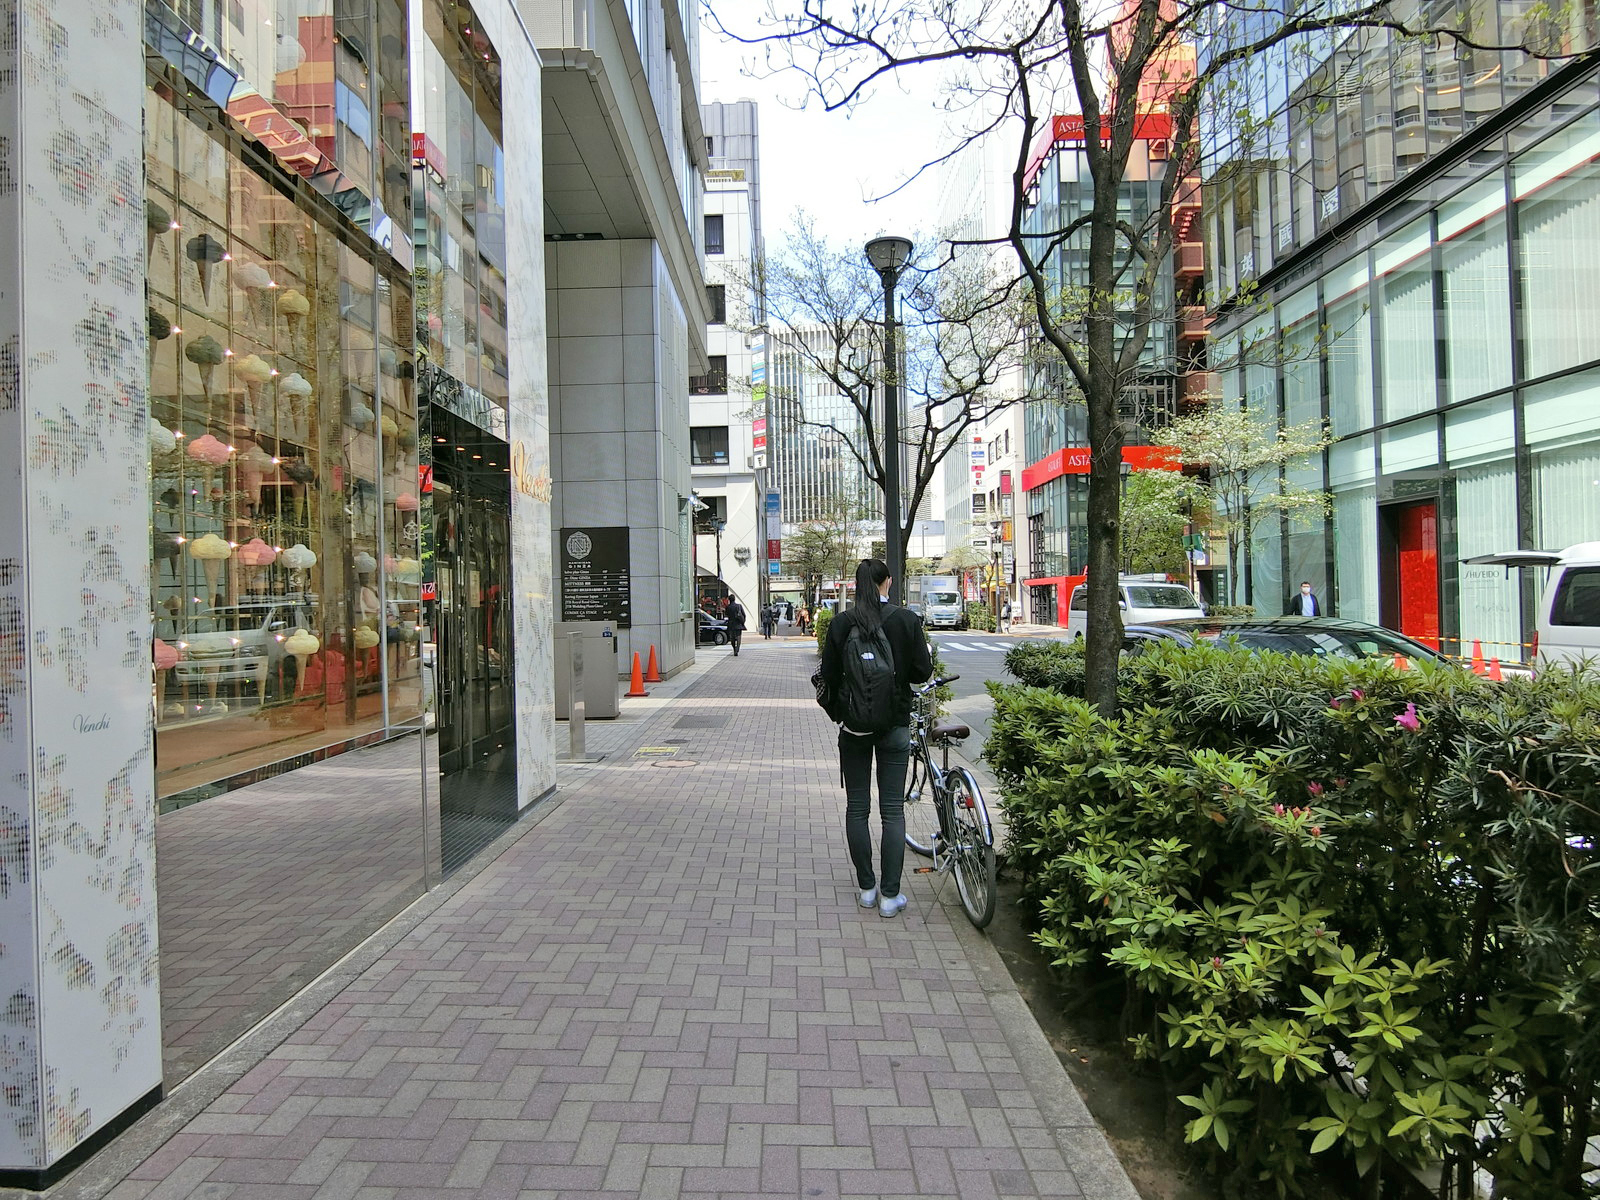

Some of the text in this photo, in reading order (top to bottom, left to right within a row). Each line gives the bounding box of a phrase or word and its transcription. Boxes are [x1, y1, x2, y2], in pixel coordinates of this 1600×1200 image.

[1058, 121, 1084, 133] ASTA
[1068, 454, 1091, 467] ASTA
[1463, 570, 1500, 579] SHISEIDO
[73, 712, 111, 734] Venchi
